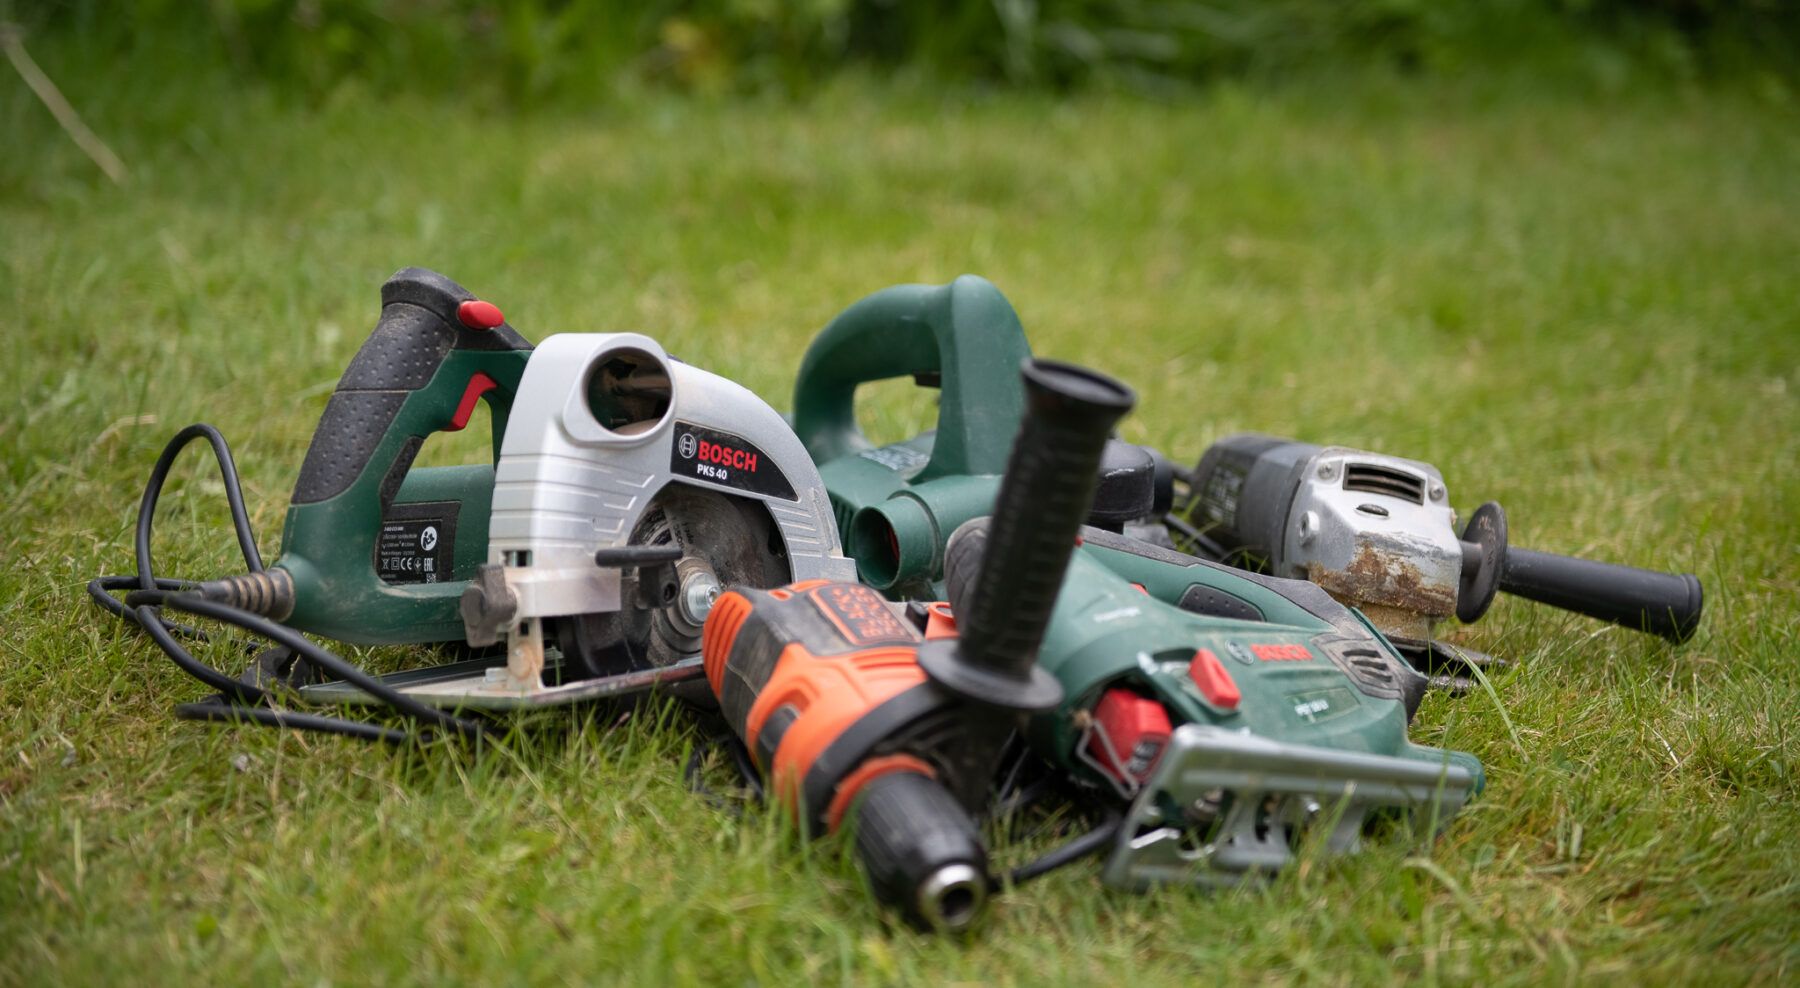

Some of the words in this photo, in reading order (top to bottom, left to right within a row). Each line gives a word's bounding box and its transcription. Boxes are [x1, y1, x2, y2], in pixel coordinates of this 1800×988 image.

[698, 440, 757, 472] BOSCH
[697, 463, 715, 477] PKS
[716, 468, 727, 480] 40
[400, 557, 412, 571] CE
